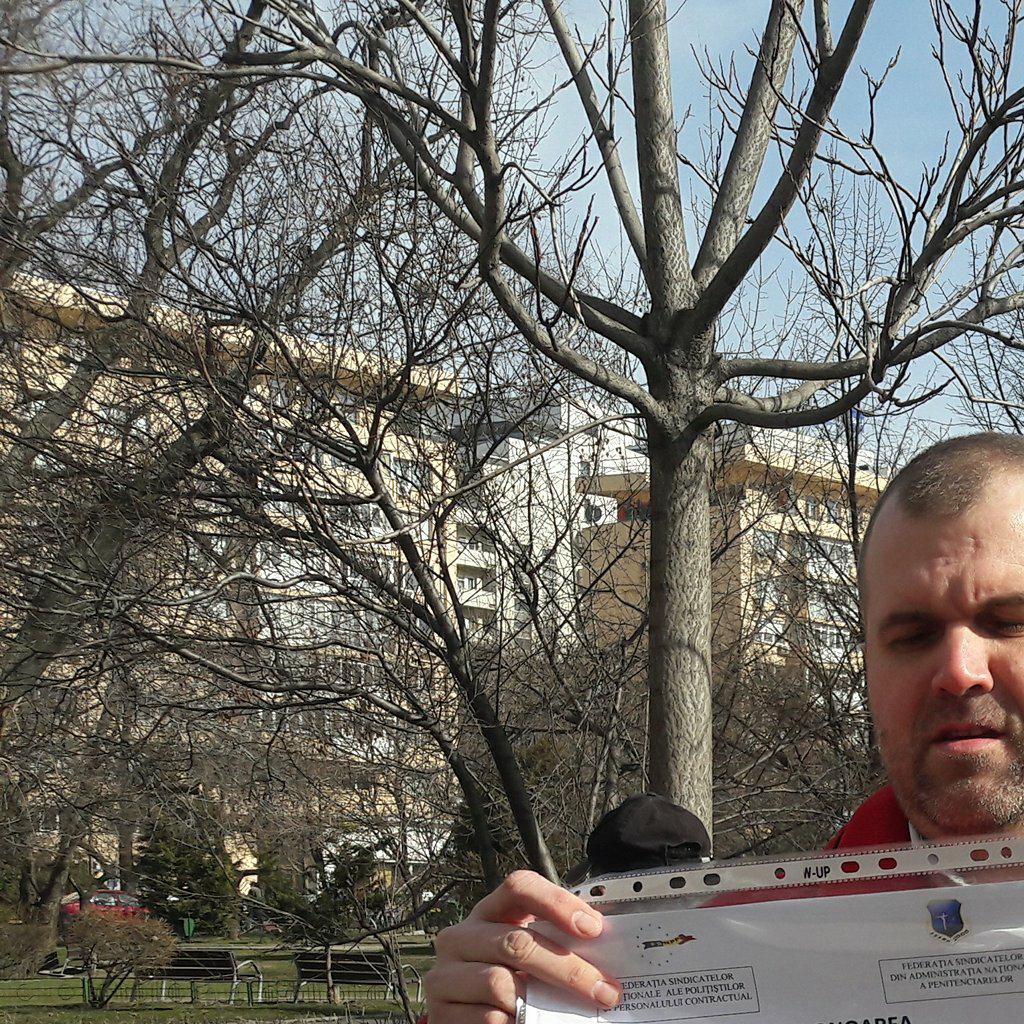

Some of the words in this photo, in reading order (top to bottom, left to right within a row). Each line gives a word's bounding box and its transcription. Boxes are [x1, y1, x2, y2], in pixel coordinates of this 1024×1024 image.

[955, 953, 1024, 966] SINDICATELOR
[622, 978, 667, 990] EDERAŢIA
[668, 973, 735, 986] SINDICATELOR
[890, 972, 907, 982] DIN
[919, 982, 927, 990] A
[928, 975, 1014, 989] PENITENCIARELOR
[666, 987, 683, 997] ALE
[614, 999, 683, 1011] PERSONALULUI
[685, 993, 752, 1006] CONTRACTUAL
